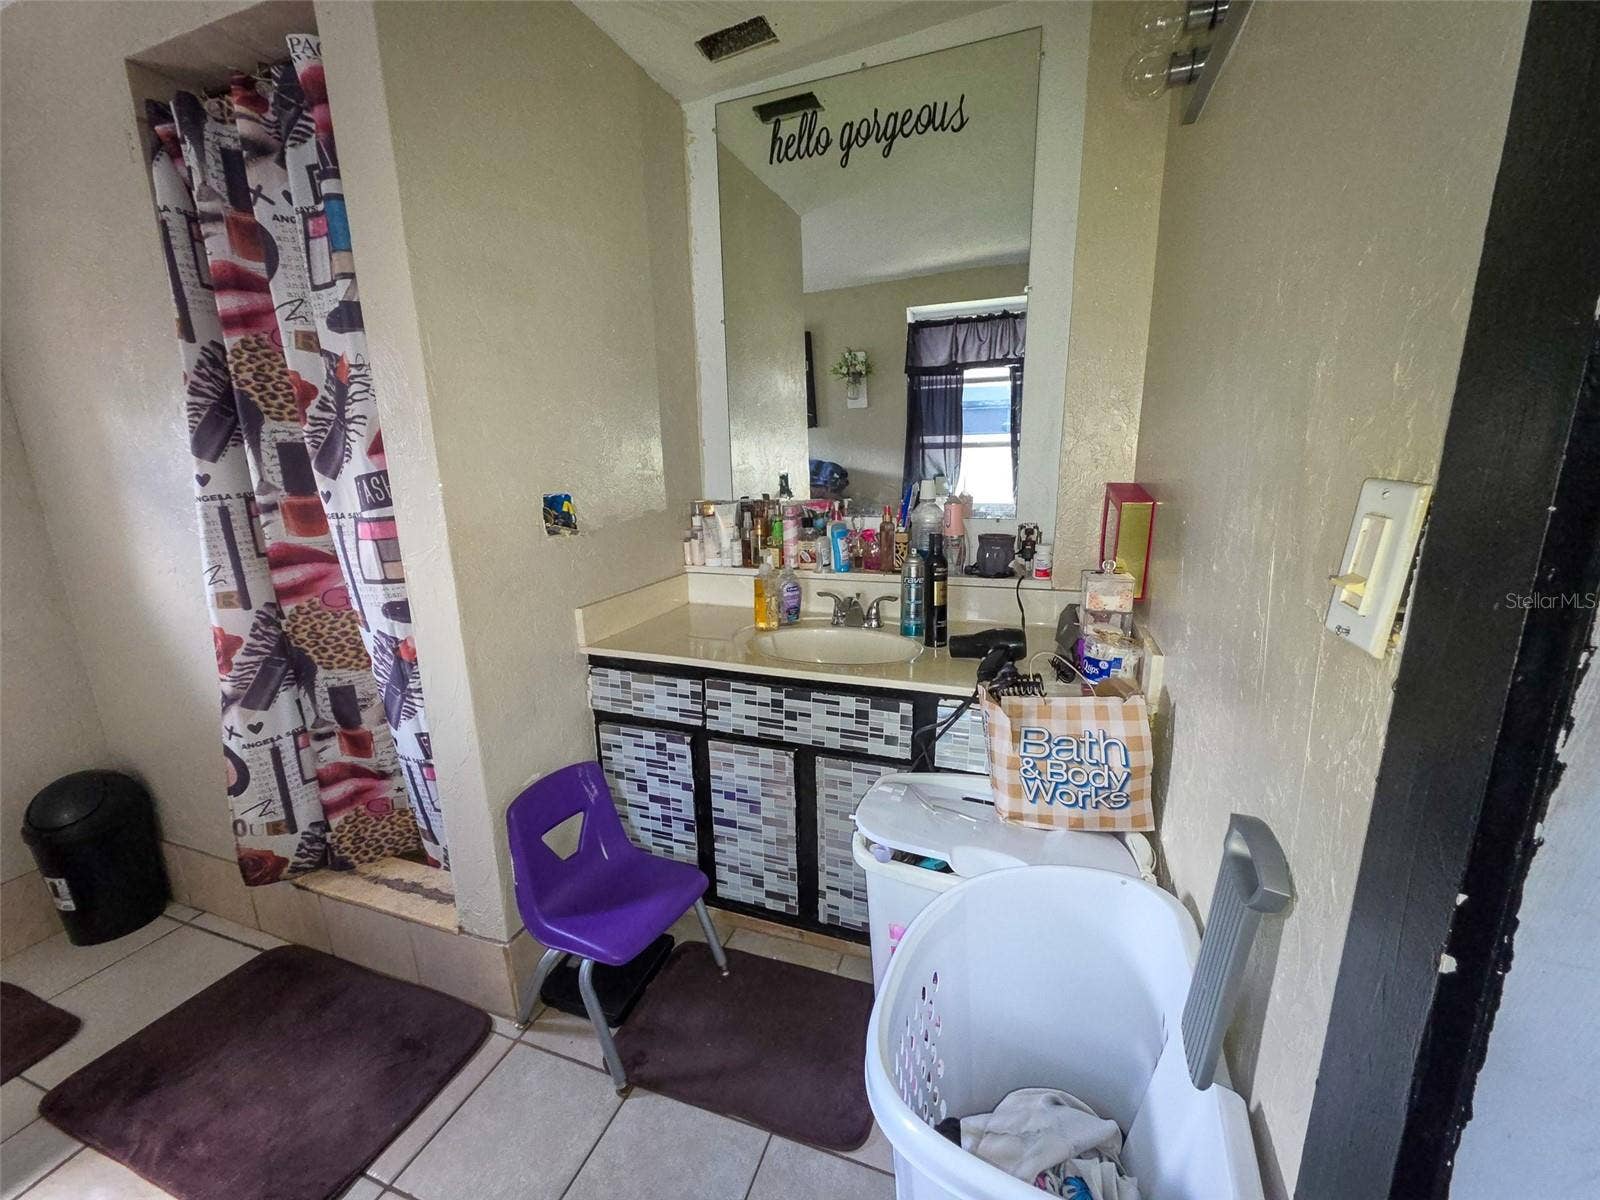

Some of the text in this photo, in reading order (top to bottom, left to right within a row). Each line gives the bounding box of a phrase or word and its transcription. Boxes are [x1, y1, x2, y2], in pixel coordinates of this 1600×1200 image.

[769, 93, 969, 168] hello gorgeous
[241, 734, 283, 750] ANGELA
[1019, 726, 1130, 769] Bath
[1019, 757, 1132, 793] & Body
[1019, 775, 1131, 810] Works
